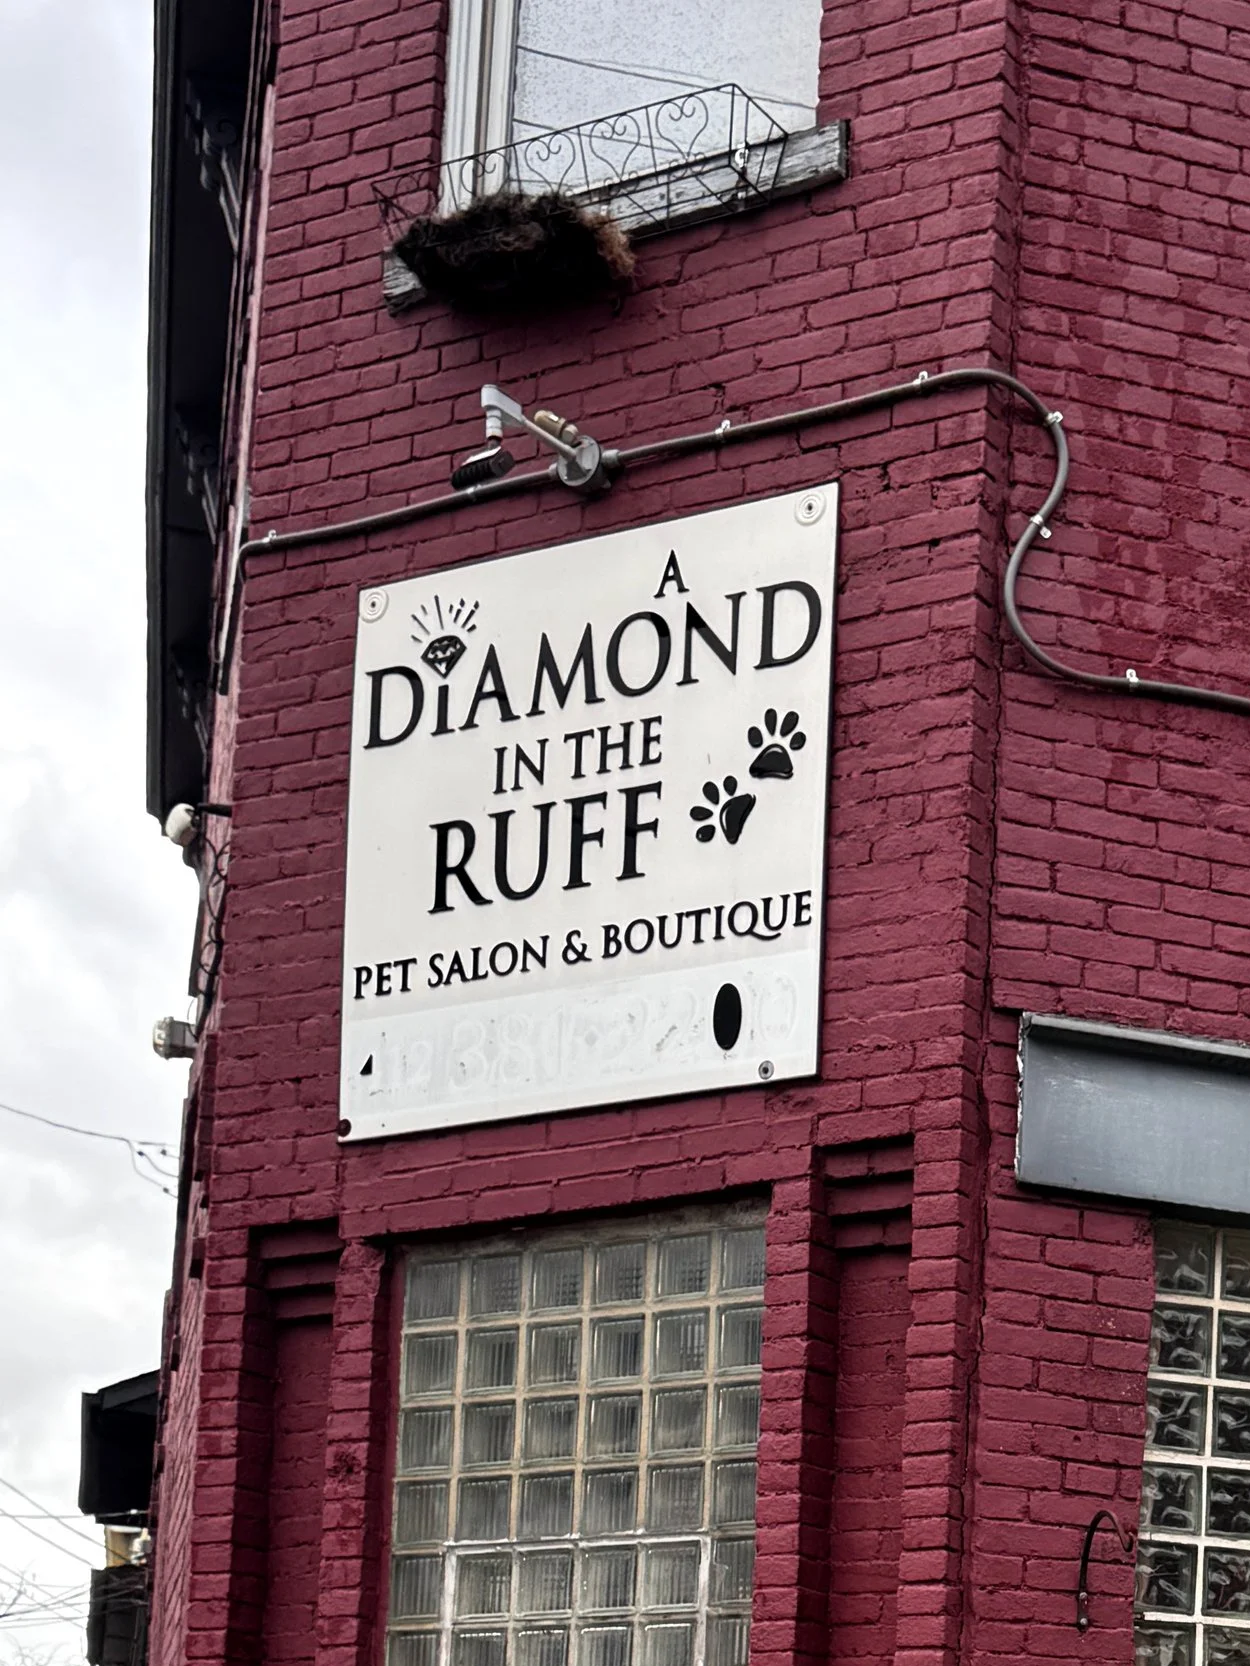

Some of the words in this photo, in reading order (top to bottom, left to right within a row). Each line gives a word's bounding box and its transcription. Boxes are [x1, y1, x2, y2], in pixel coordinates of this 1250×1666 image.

[653, 549, 690, 599] A
[492, 737, 551, 796] IN
[563, 715, 663, 780] THE
[427, 780, 663, 916] RUFF
[353, 957, 418, 1001] PET
[427, 934, 550, 989] SALON
[561, 929, 593, 966] &
[601, 889, 812, 960] BOUTIQUE
